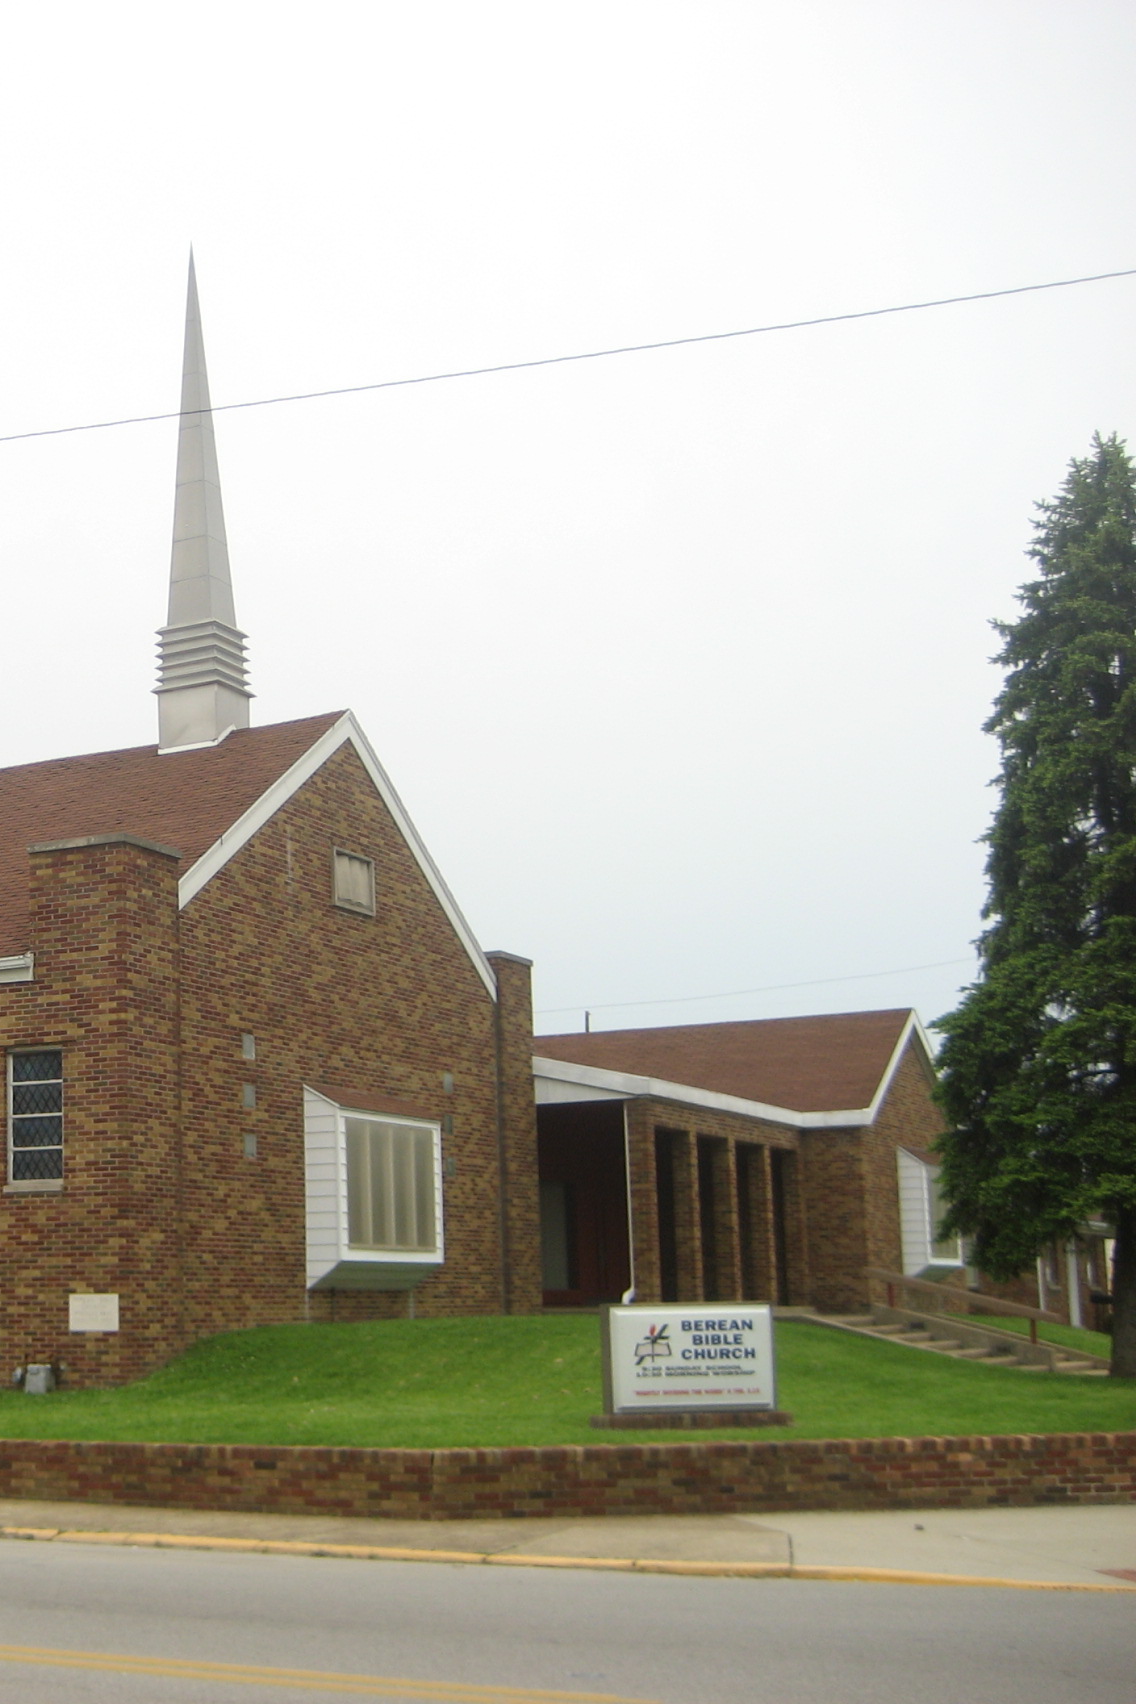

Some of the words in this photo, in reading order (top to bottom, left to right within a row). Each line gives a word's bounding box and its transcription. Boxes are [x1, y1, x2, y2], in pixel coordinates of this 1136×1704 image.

[681, 1319, 753, 1332] BEREAN
[692, 1333, 743, 1346] BIBLE
[681, 1348, 756, 1361] CHURCH
